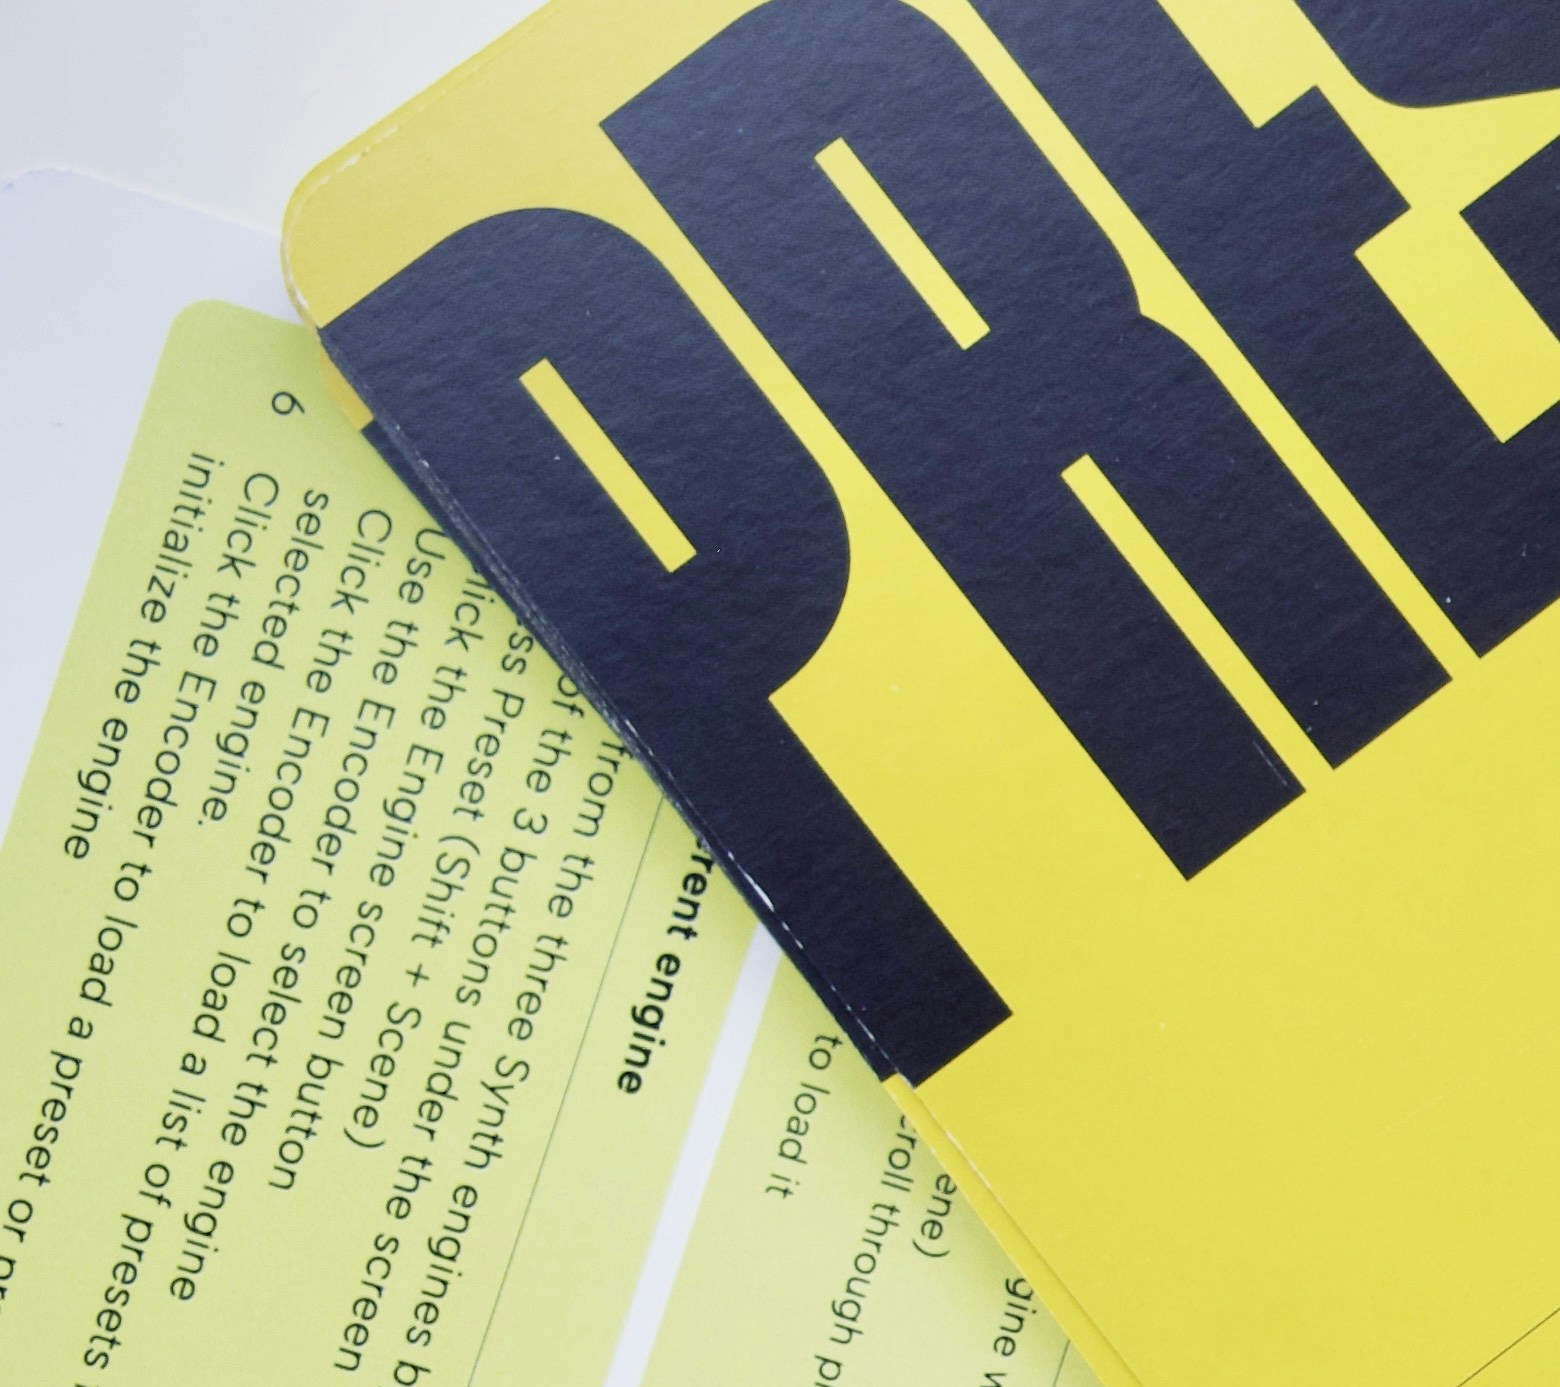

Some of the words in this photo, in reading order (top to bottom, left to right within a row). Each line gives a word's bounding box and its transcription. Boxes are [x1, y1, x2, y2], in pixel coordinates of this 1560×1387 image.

[269, 390, 305, 416] 6
[139, 452, 224, 624] initialize
[216, 471, 279, 578] Click
[329, 508, 393, 615] Click
[398, 527, 450, 605] Use
[191, 592, 239, 657] the
[250, 488, 329, 670] selected
[113, 638, 161, 704] the
[304, 628, 353, 694] the
[370, 619, 418, 685] the
[419, 664, 467, 730] the
[552, 675, 585, 719] of
[62, 716, 128, 860] engine
[131, 670, 217, 849] Encoder
[196, 679, 266, 826] engine.
[244, 706, 330, 884] Encoder
[310, 697, 396, 876] Encoder
[451, 687, 525, 821] Preset
[524, 728, 572, 793] the
[573, 741, 632, 838] from
[368, 743, 444, 887] Engine
[511, 807, 548, 835] 3
[112, 861, 152, 902] to
[225, 897, 265, 938] to
[291, 888, 331, 930] to
[410, 834, 480, 948] (Shift
[454, 845, 537, 1006] buttons
[546, 853, 594, 918] the
[78, 914, 138, 1007] load
[191, 950, 251, 1043] load
[244, 942, 306, 1068] select
[316, 900, 383, 1040] screen
[405, 963, 429, 987] +
[506, 934, 568, 1041] three
[66, 1015, 93, 1040] a
[178, 1051, 207, 1076] a
[616, 952, 681, 1094] engine
[808, 1033, 844, 1071] to
[17, 1049, 82, 1187] preset
[153, 1088, 206, 1151] list
[219, 1080, 268, 1147] the
[267, 1052, 344, 1191] button
[342, 1001, 422, 1149] Scene)
[412, 1020, 471, 1141] under
[463, 1054, 530, 1170] Synth
[776, 1081, 830, 1165] load
[1, 1198, 33, 1244] or
[137, 1162, 172, 1209] of
[168, 1159, 234, 1301] engine
[384, 1154, 432, 1220] the
[764, 1173, 793, 1198] it
[81, 1212, 153, 1370] presets
[332, 1232, 399, 1372] screen
[404, 1183, 478, 1347] engines
[828, 1202, 900, 1345] through
